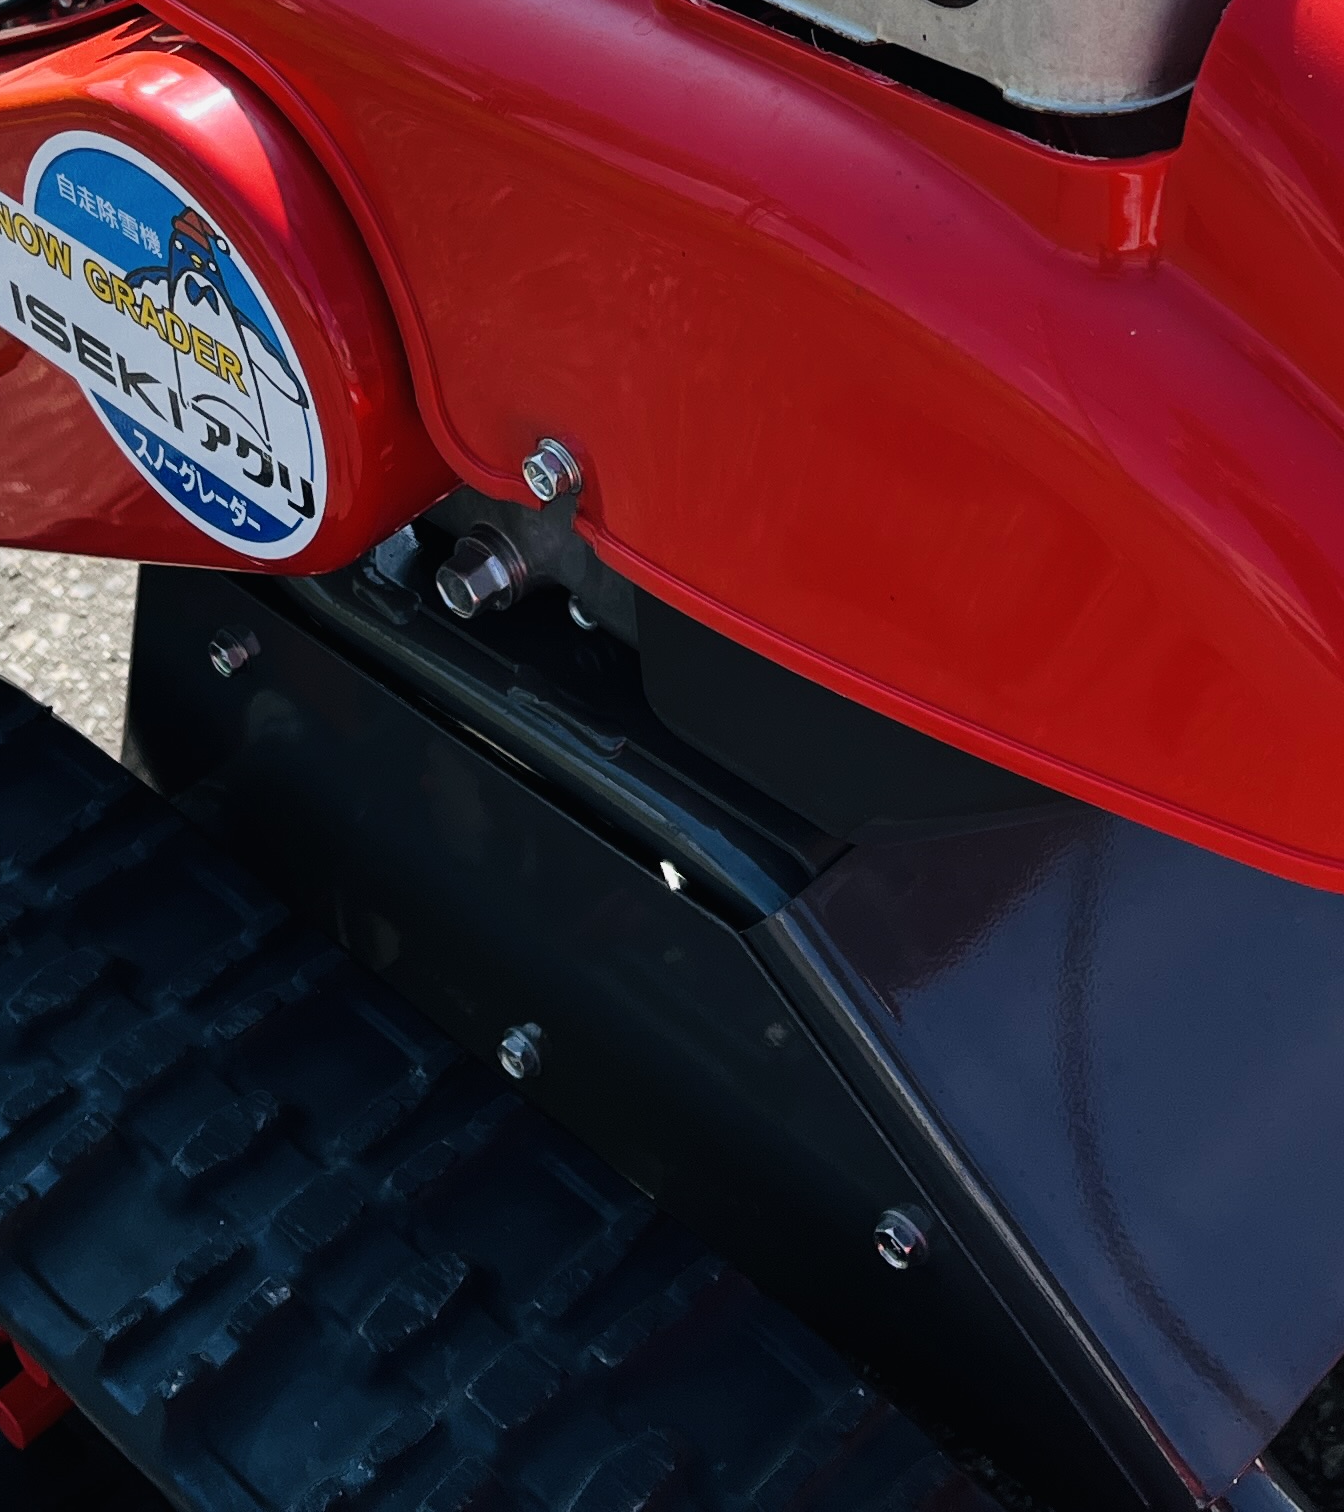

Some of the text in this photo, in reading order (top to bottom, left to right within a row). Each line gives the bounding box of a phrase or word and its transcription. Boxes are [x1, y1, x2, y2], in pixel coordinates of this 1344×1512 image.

[56, 173, 163, 259] 自走除雪機
[83, 259, 250, 397] GRADER
[133, 428, 261, 532] スノーグレーダー
